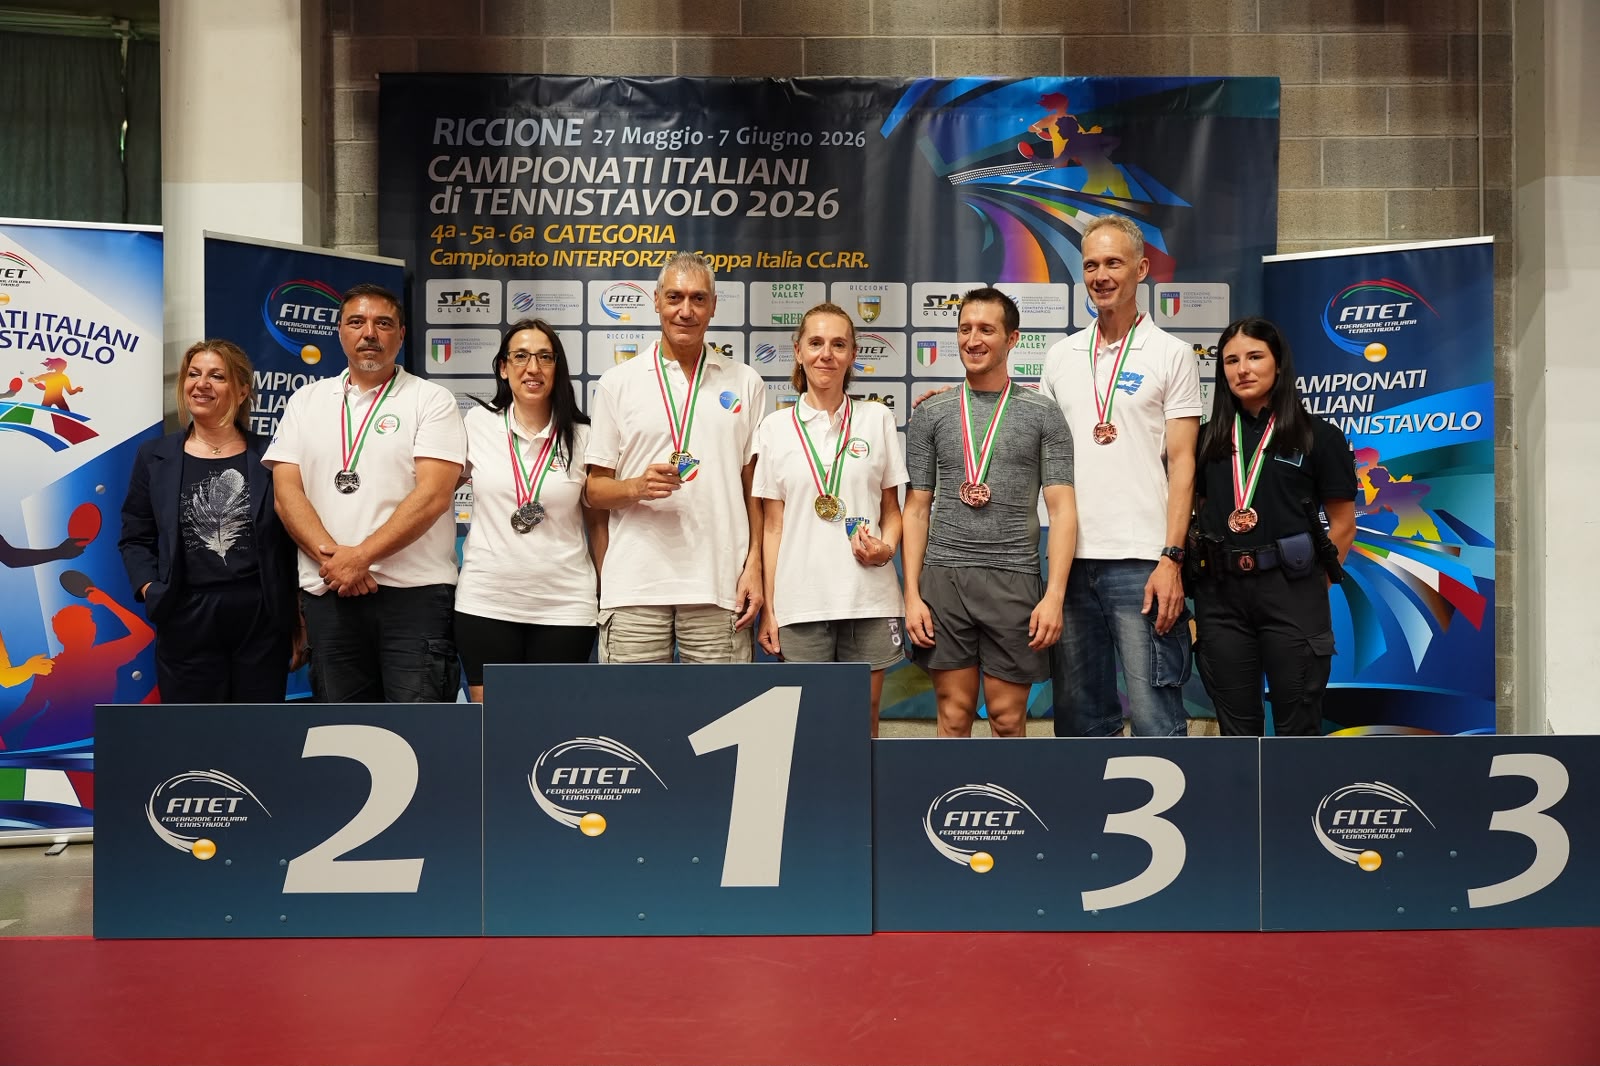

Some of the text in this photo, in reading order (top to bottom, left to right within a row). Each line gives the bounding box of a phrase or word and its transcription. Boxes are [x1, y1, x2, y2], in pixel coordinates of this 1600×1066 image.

[433, 118, 584, 147] RICCIONE
[592, 129, 615, 146] 27
[621, 126, 704, 150] Maggio
[718, 130, 730, 147] 7
[736, 126, 813, 151] Giugno
[819, 130, 866, 147] 2026
[428, 156, 809, 185] CAMPIONATI ITALIANI
[430, 187, 840, 219] di TENNISTAVOLO 2026
[543, 224, 676, 244] CATEGORIA
[430, 249, 549, 270] Campionato
[756, 250, 803, 268] Italia
[805, 252, 869, 268] CC.RR.
[437, 290, 490, 305] STAG
[608, 295, 643, 303] FITET
[923, 294, 962, 307] STA
[280, 303, 340, 323] FITET
[1339, 302, 1413, 322] FITET
[35, 312, 139, 353] ITALIANI
[1335, 319, 1417, 330] FEDERAZIONE ITALIANA
[1020, 334, 1047, 342] PORT
[1295, 369, 1427, 394] AMPIONATI
[1301, 394, 1375, 415] ALIANI
[1323, 411, 1482, 435] NNISTAVOLO
[551, 767, 636, 785] FITET
[688, 686, 802, 887] 1
[166, 797, 244, 814] FITET
[282, 724, 425, 893] 2
[943, 811, 1020, 827] FITET
[1332, 809, 1408, 826] FITET
[1081, 755, 1187, 911] 3
[1467, 753, 1570, 908] 3
